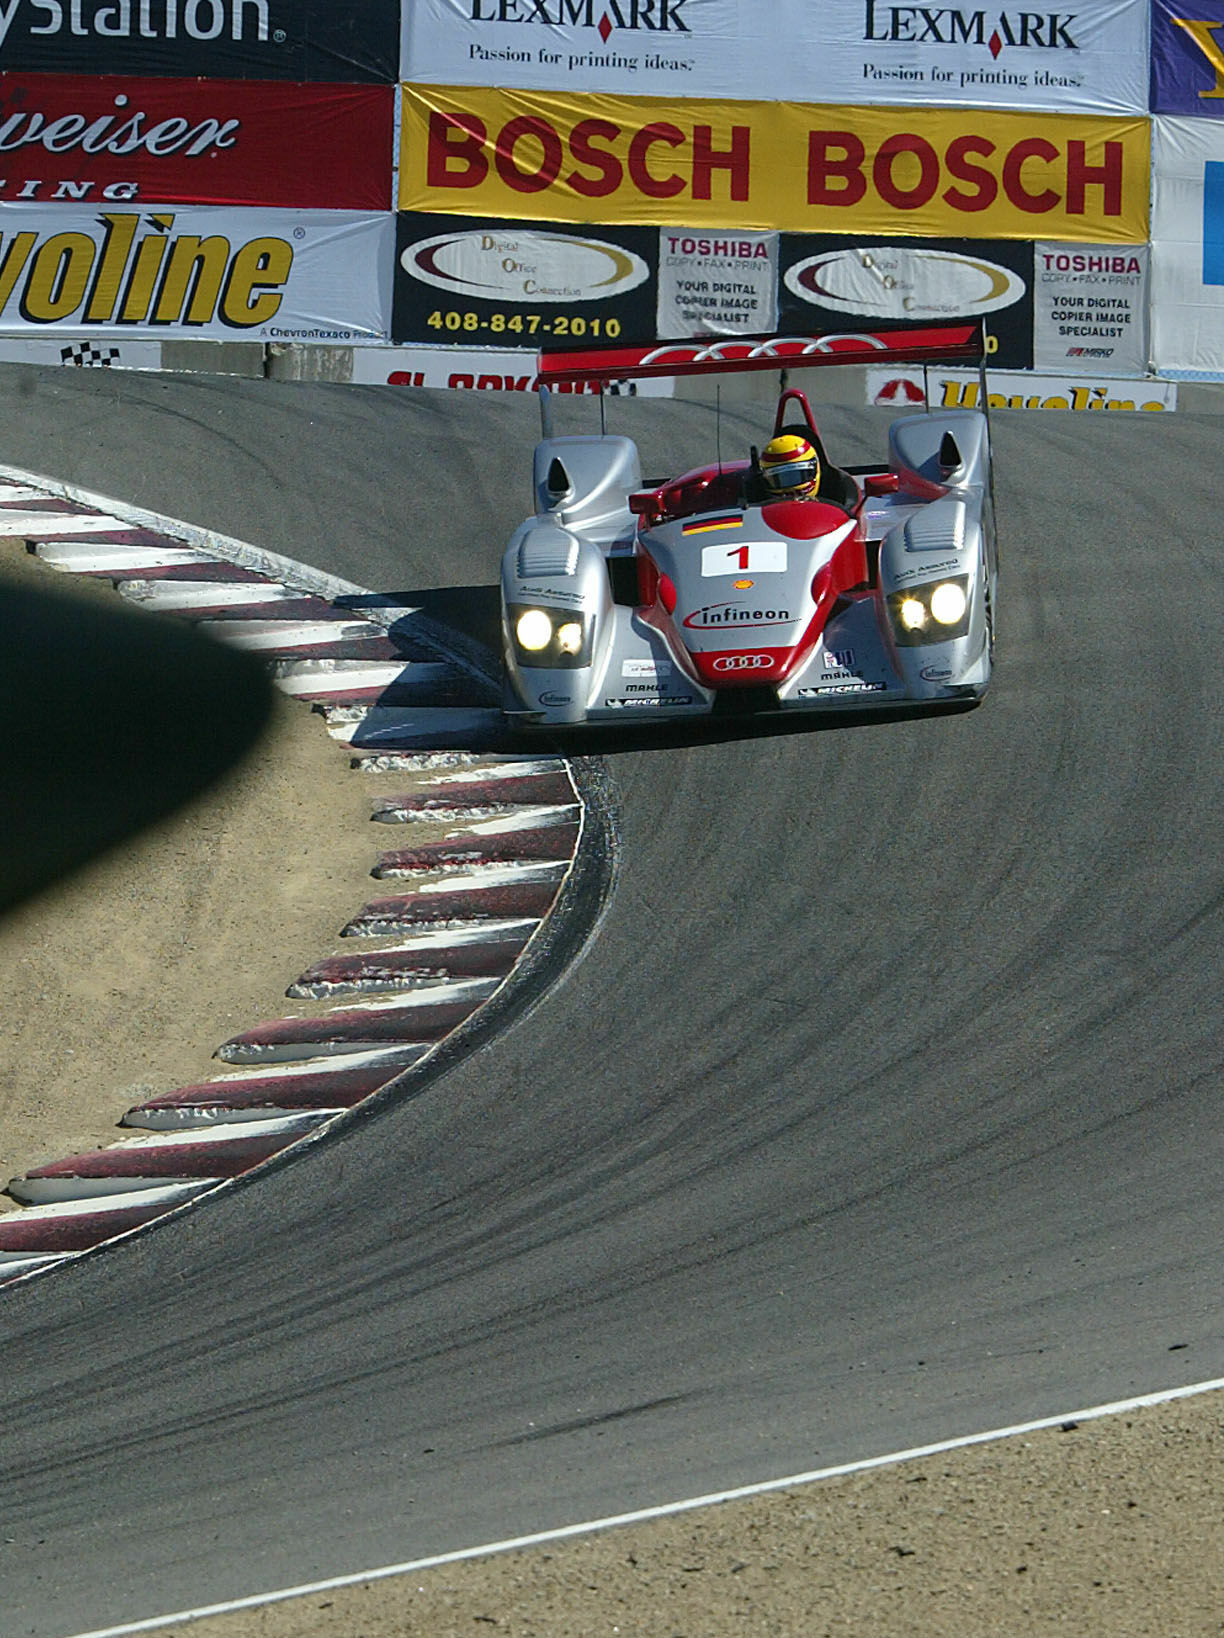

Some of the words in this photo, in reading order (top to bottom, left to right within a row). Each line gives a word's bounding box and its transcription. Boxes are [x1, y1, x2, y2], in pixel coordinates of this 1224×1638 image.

[862, 0, 1080, 49] LEXMARK
[469, 43, 532, 63] Passion
[538, 48, 563, 65] for
[568, 51, 639, 72] printing
[862, 62, 925, 82] Passion
[931, 65, 955, 83] for
[959, 67, 1029, 88] printing
[426, 110, 752, 203] BOSCH
[806, 129, 1125, 217] BOSCH
[667, 236, 769, 259] TOSHIBA
[1042, 253, 1142, 274] TOSHIBA
[676, 280, 709, 293] YOUR
[712, 282, 757, 295] DIGITAL
[675, 295, 718, 308] COPIER
[720, 298, 759, 310] IMAGE
[1052, 296, 1084, 309] YOUR
[1087, 297, 1131, 310] DIGITAL
[426, 310, 622, 338] 408-847-2010
[1051, 310, 1093, 322] COPIER
[1095, 312, 1132, 324] IMAGE
[269, 327, 351, 340] ChevronTexaco
[1058, 325, 1124, 338] SPECIALIST
[726, 545, 750, 570] 1
[820, 669, 864, 682] MAHLE
[625, 684, 669, 693] MAHLE
[817, 681, 884, 694] MICHELIN
